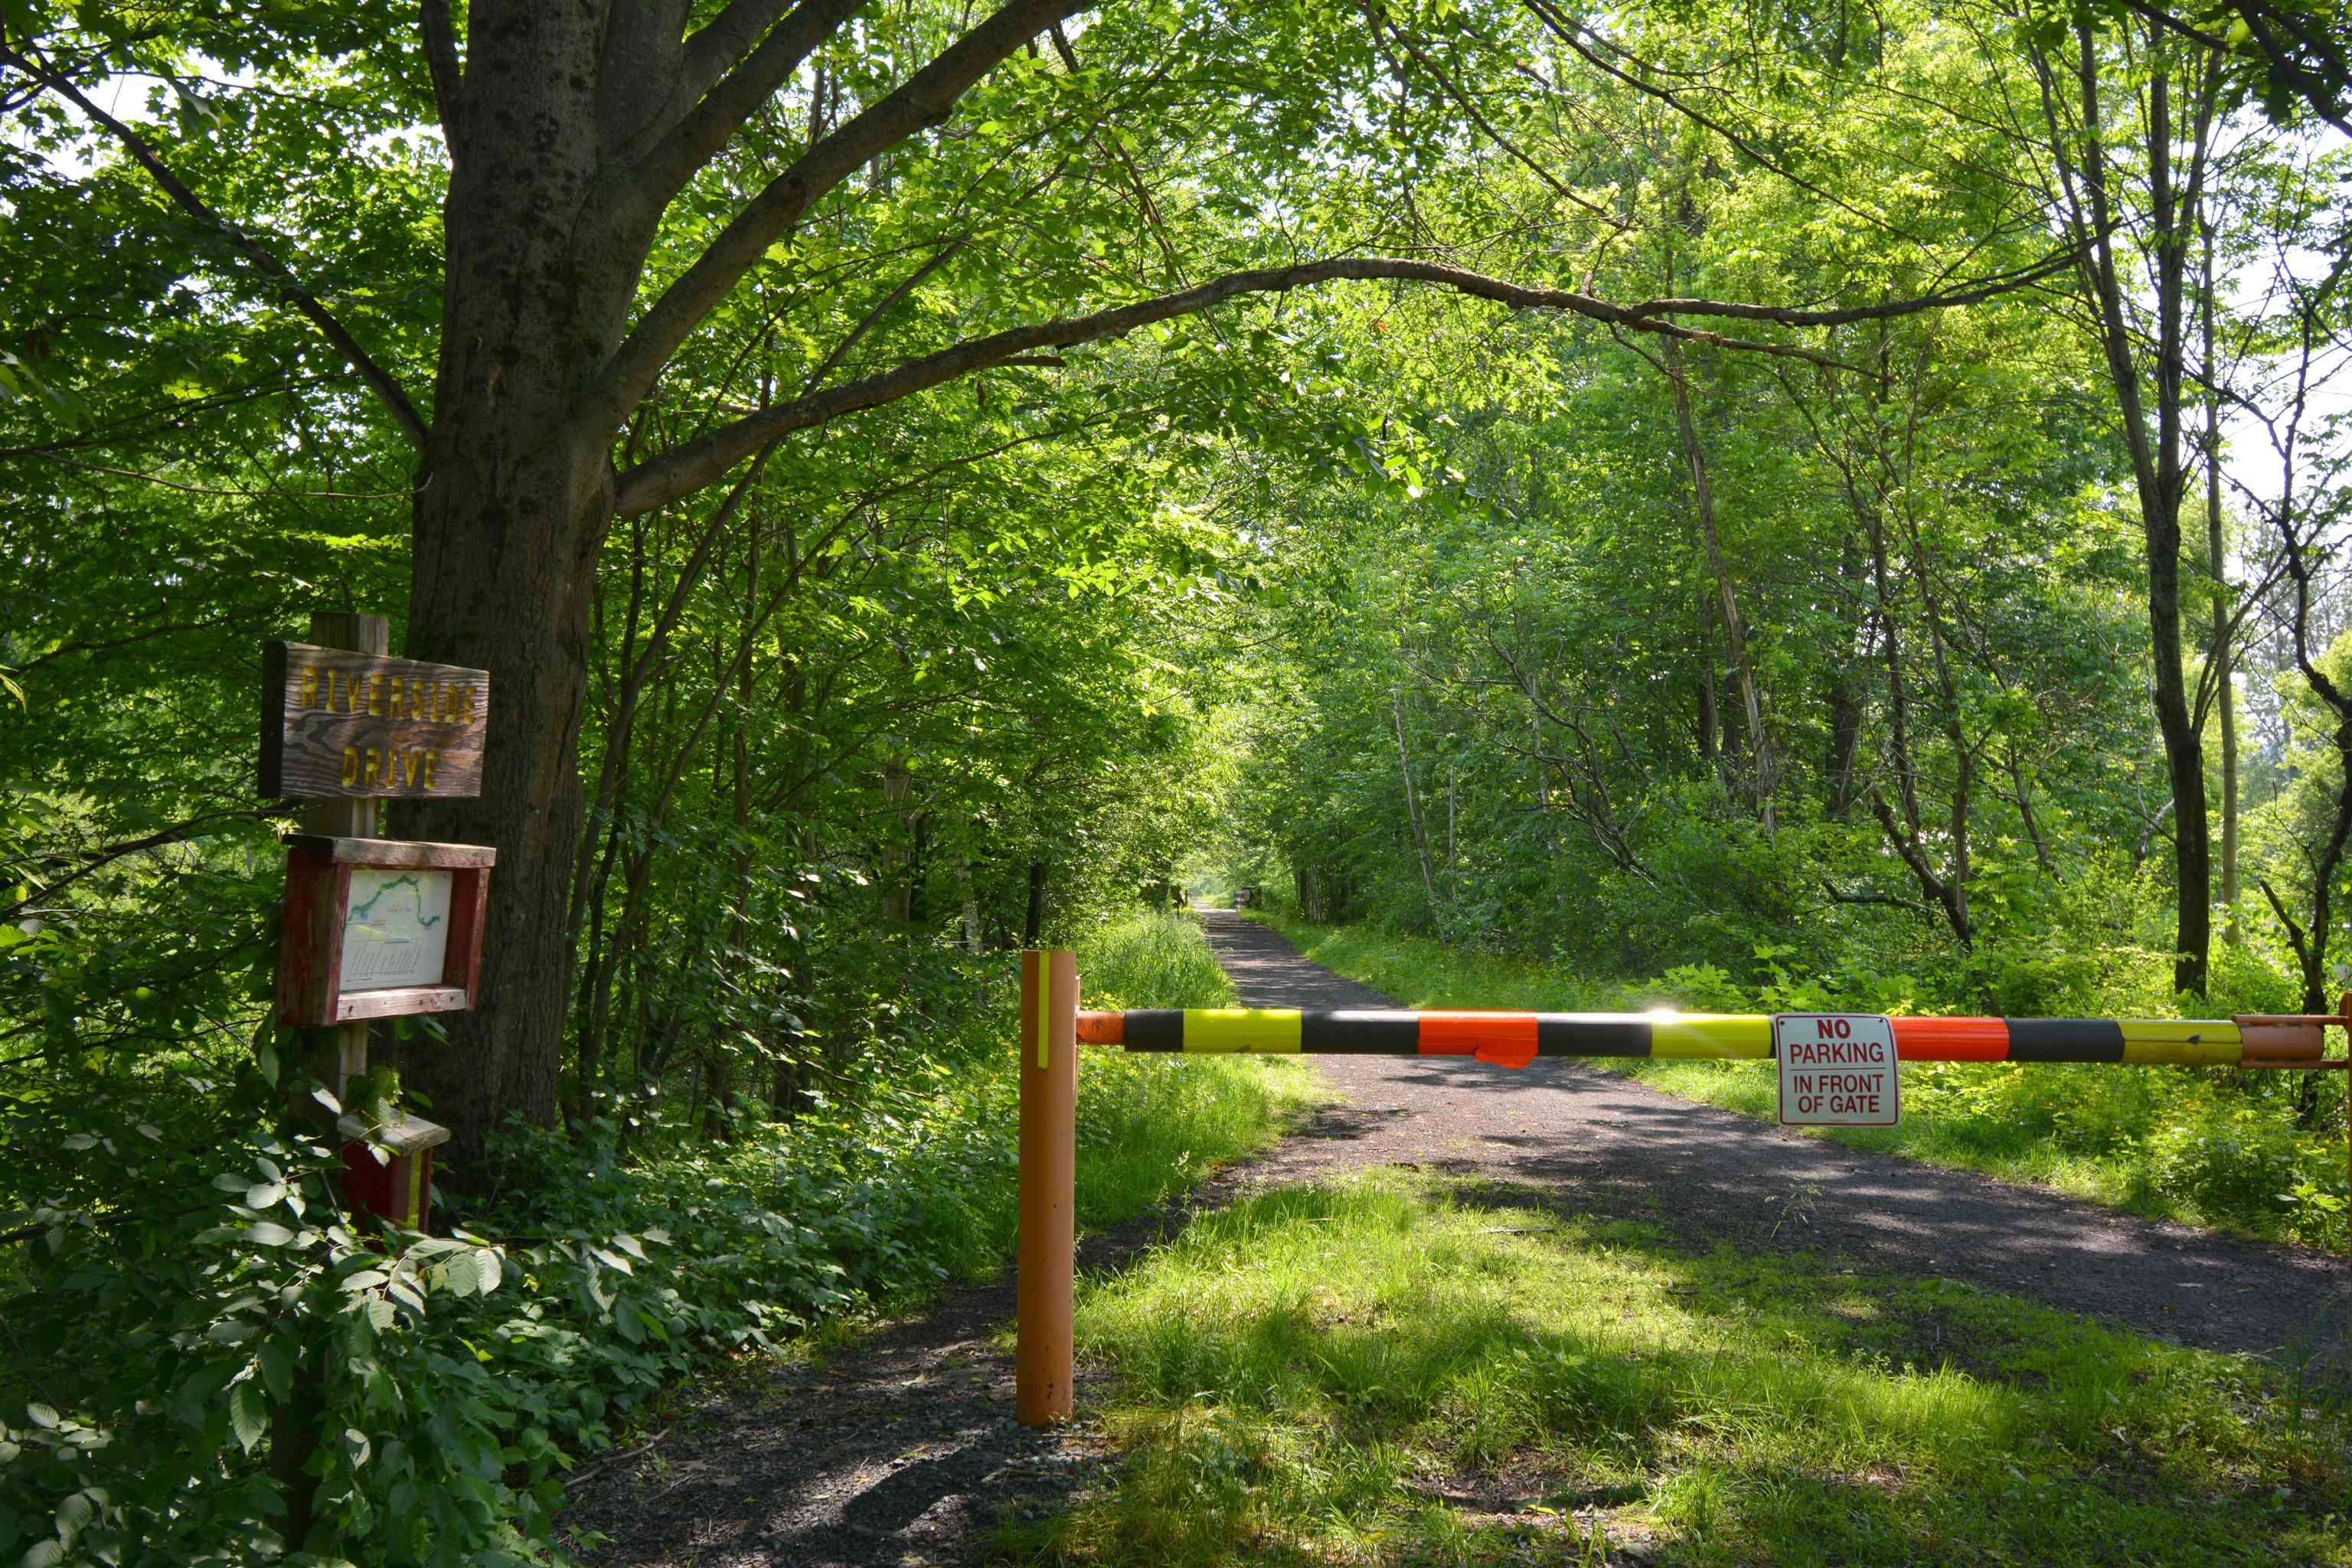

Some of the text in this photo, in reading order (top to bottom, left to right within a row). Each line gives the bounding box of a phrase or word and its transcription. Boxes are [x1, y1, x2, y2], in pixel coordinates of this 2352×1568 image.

[301, 665, 476, 724] RIVERSIDE
[342, 746, 436, 789] DRIVE
[1817, 1019, 1851, 1039] NO
[1789, 1042, 1884, 1064] PARKING
[1794, 1074, 1884, 1093] IN FRONT
[1798, 1095, 1880, 1114] OF GATE
